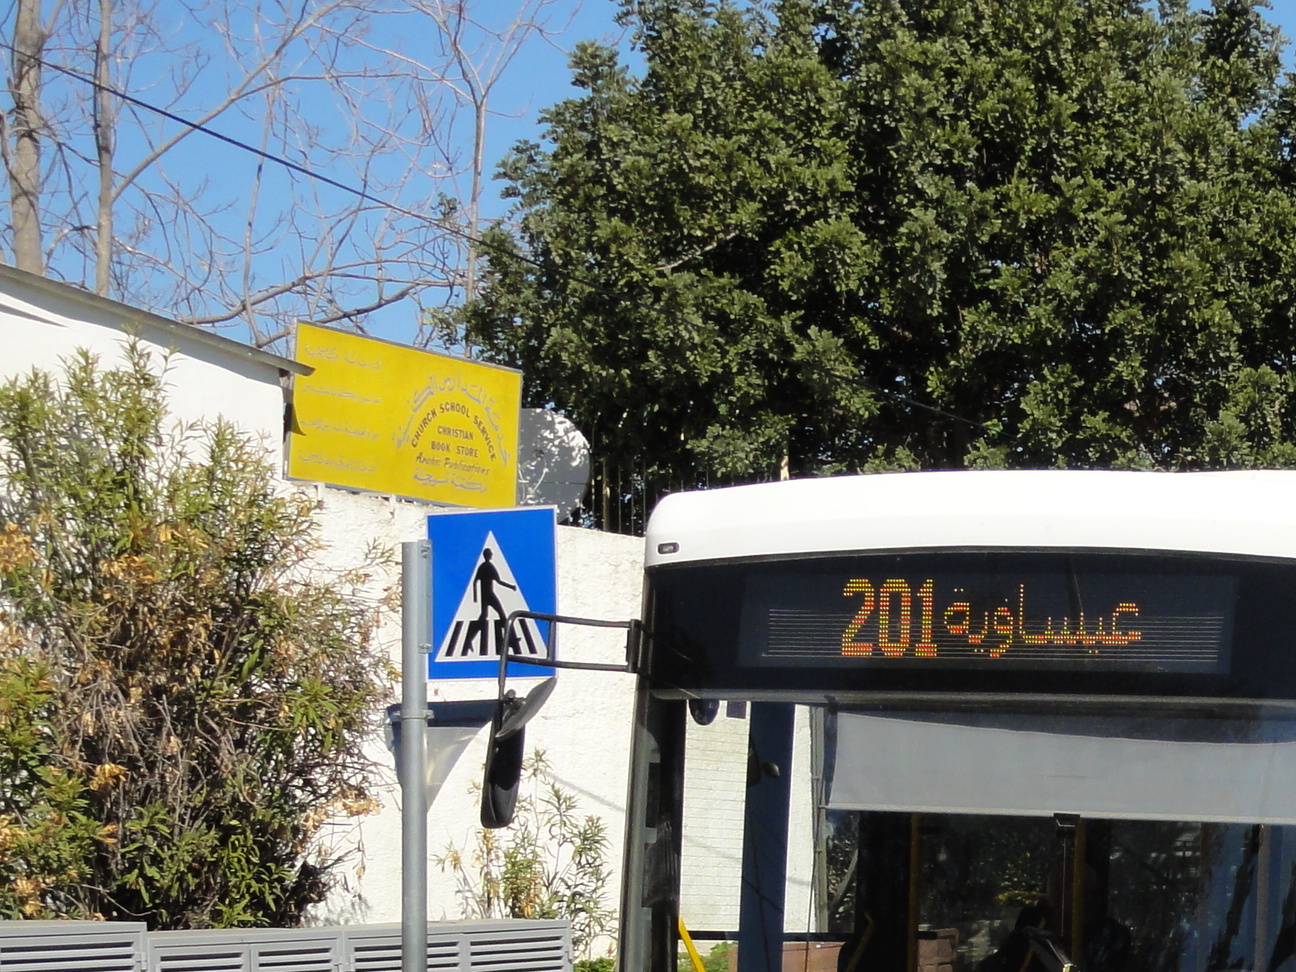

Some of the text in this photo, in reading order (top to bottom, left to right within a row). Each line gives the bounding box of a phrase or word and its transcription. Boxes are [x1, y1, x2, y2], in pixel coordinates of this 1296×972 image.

[411, 408, 437, 448] CHURCH
[440, 402, 470, 418] SCHOOL
[473, 415, 497, 462] SERVICE
[437, 425, 474, 441] CHRISTIAN
[431, 441, 479, 459] BOOK STORE
[443, 457, 490, 476] Publications
[842, 578, 938, 658] 201
